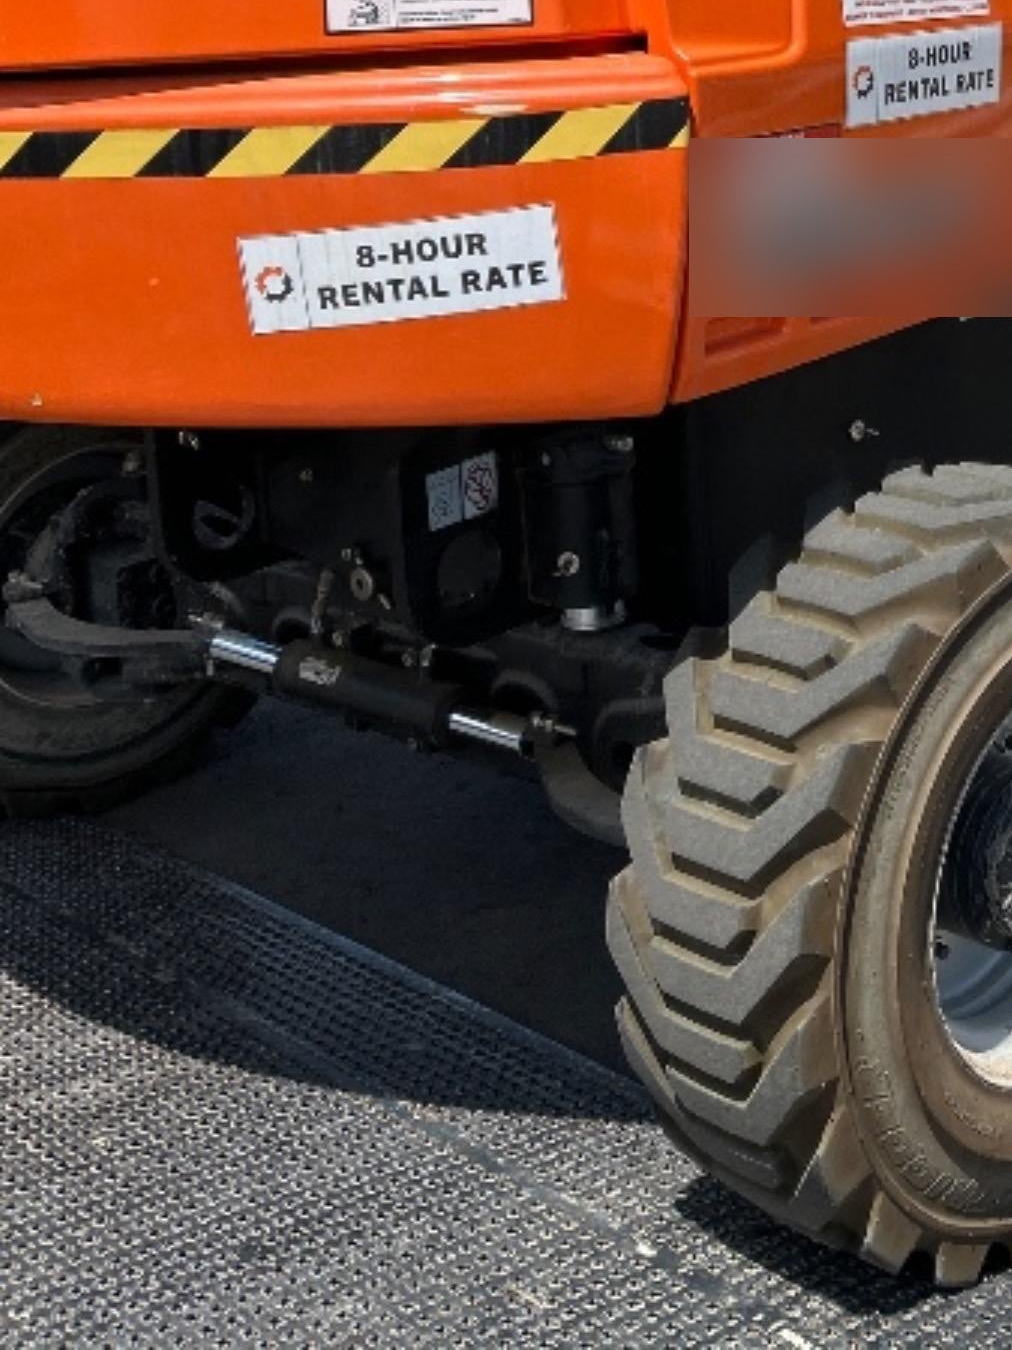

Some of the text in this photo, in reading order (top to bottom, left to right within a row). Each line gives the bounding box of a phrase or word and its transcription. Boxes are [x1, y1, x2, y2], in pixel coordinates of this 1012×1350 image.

[907, 41, 973, 70] 8-HOUR
[884, 68, 995, 106] RENTAL RATE
[355, 233, 488, 269] 8-HOUR
[317, 260, 548, 311] RENTAL RATE
